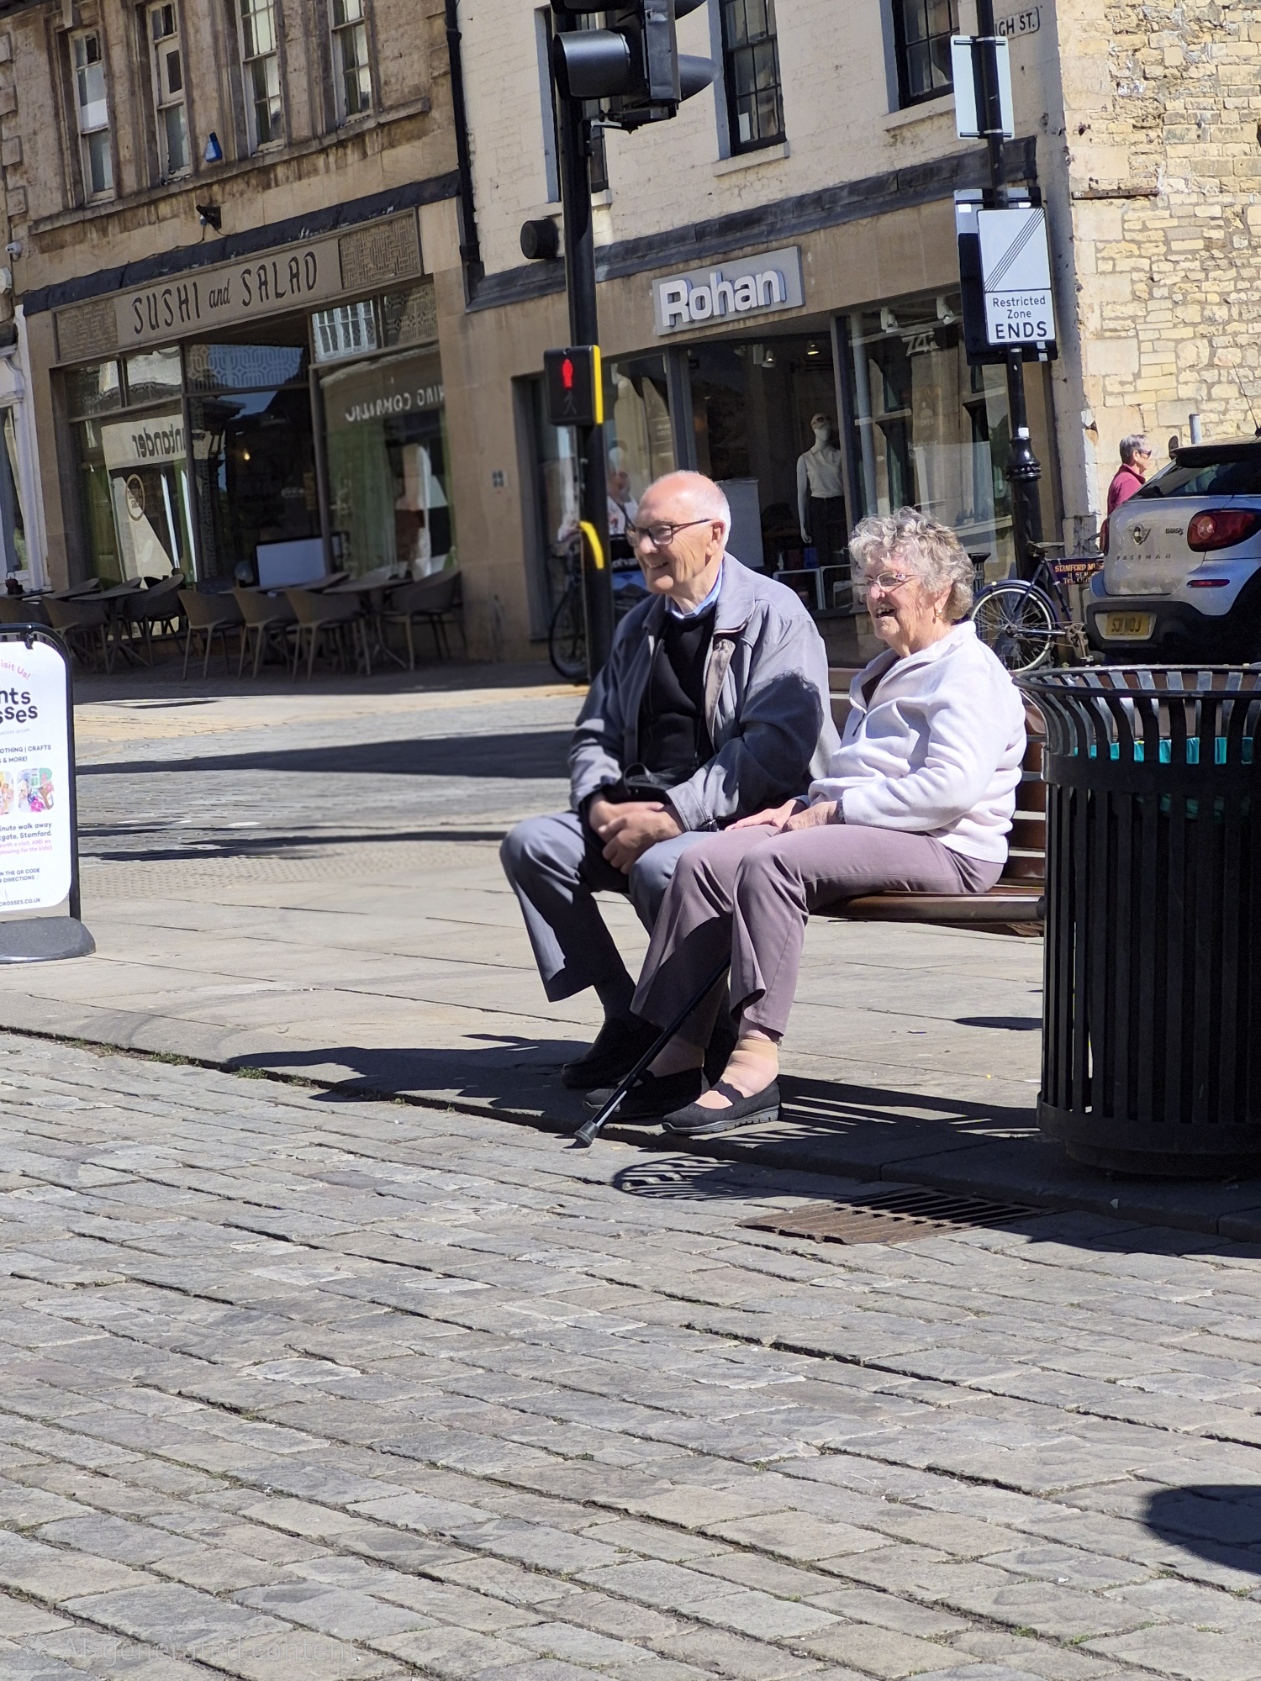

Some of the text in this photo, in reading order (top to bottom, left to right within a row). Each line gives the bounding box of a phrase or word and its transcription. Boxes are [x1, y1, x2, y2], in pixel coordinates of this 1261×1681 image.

[994, 12, 1036, 37] IGH ST.
[131, 251, 318, 335] SUSHI and SALAD
[659, 270, 787, 327] Rohan
[992, 295, 1046, 308] Restricted
[1006, 309, 1032, 319] Zone
[995, 320, 1048, 340] ENDS
[0, 659, 15, 671] isit
[0, 687, 31, 705] nts
[28, 744, 52, 752] CRAFTS
